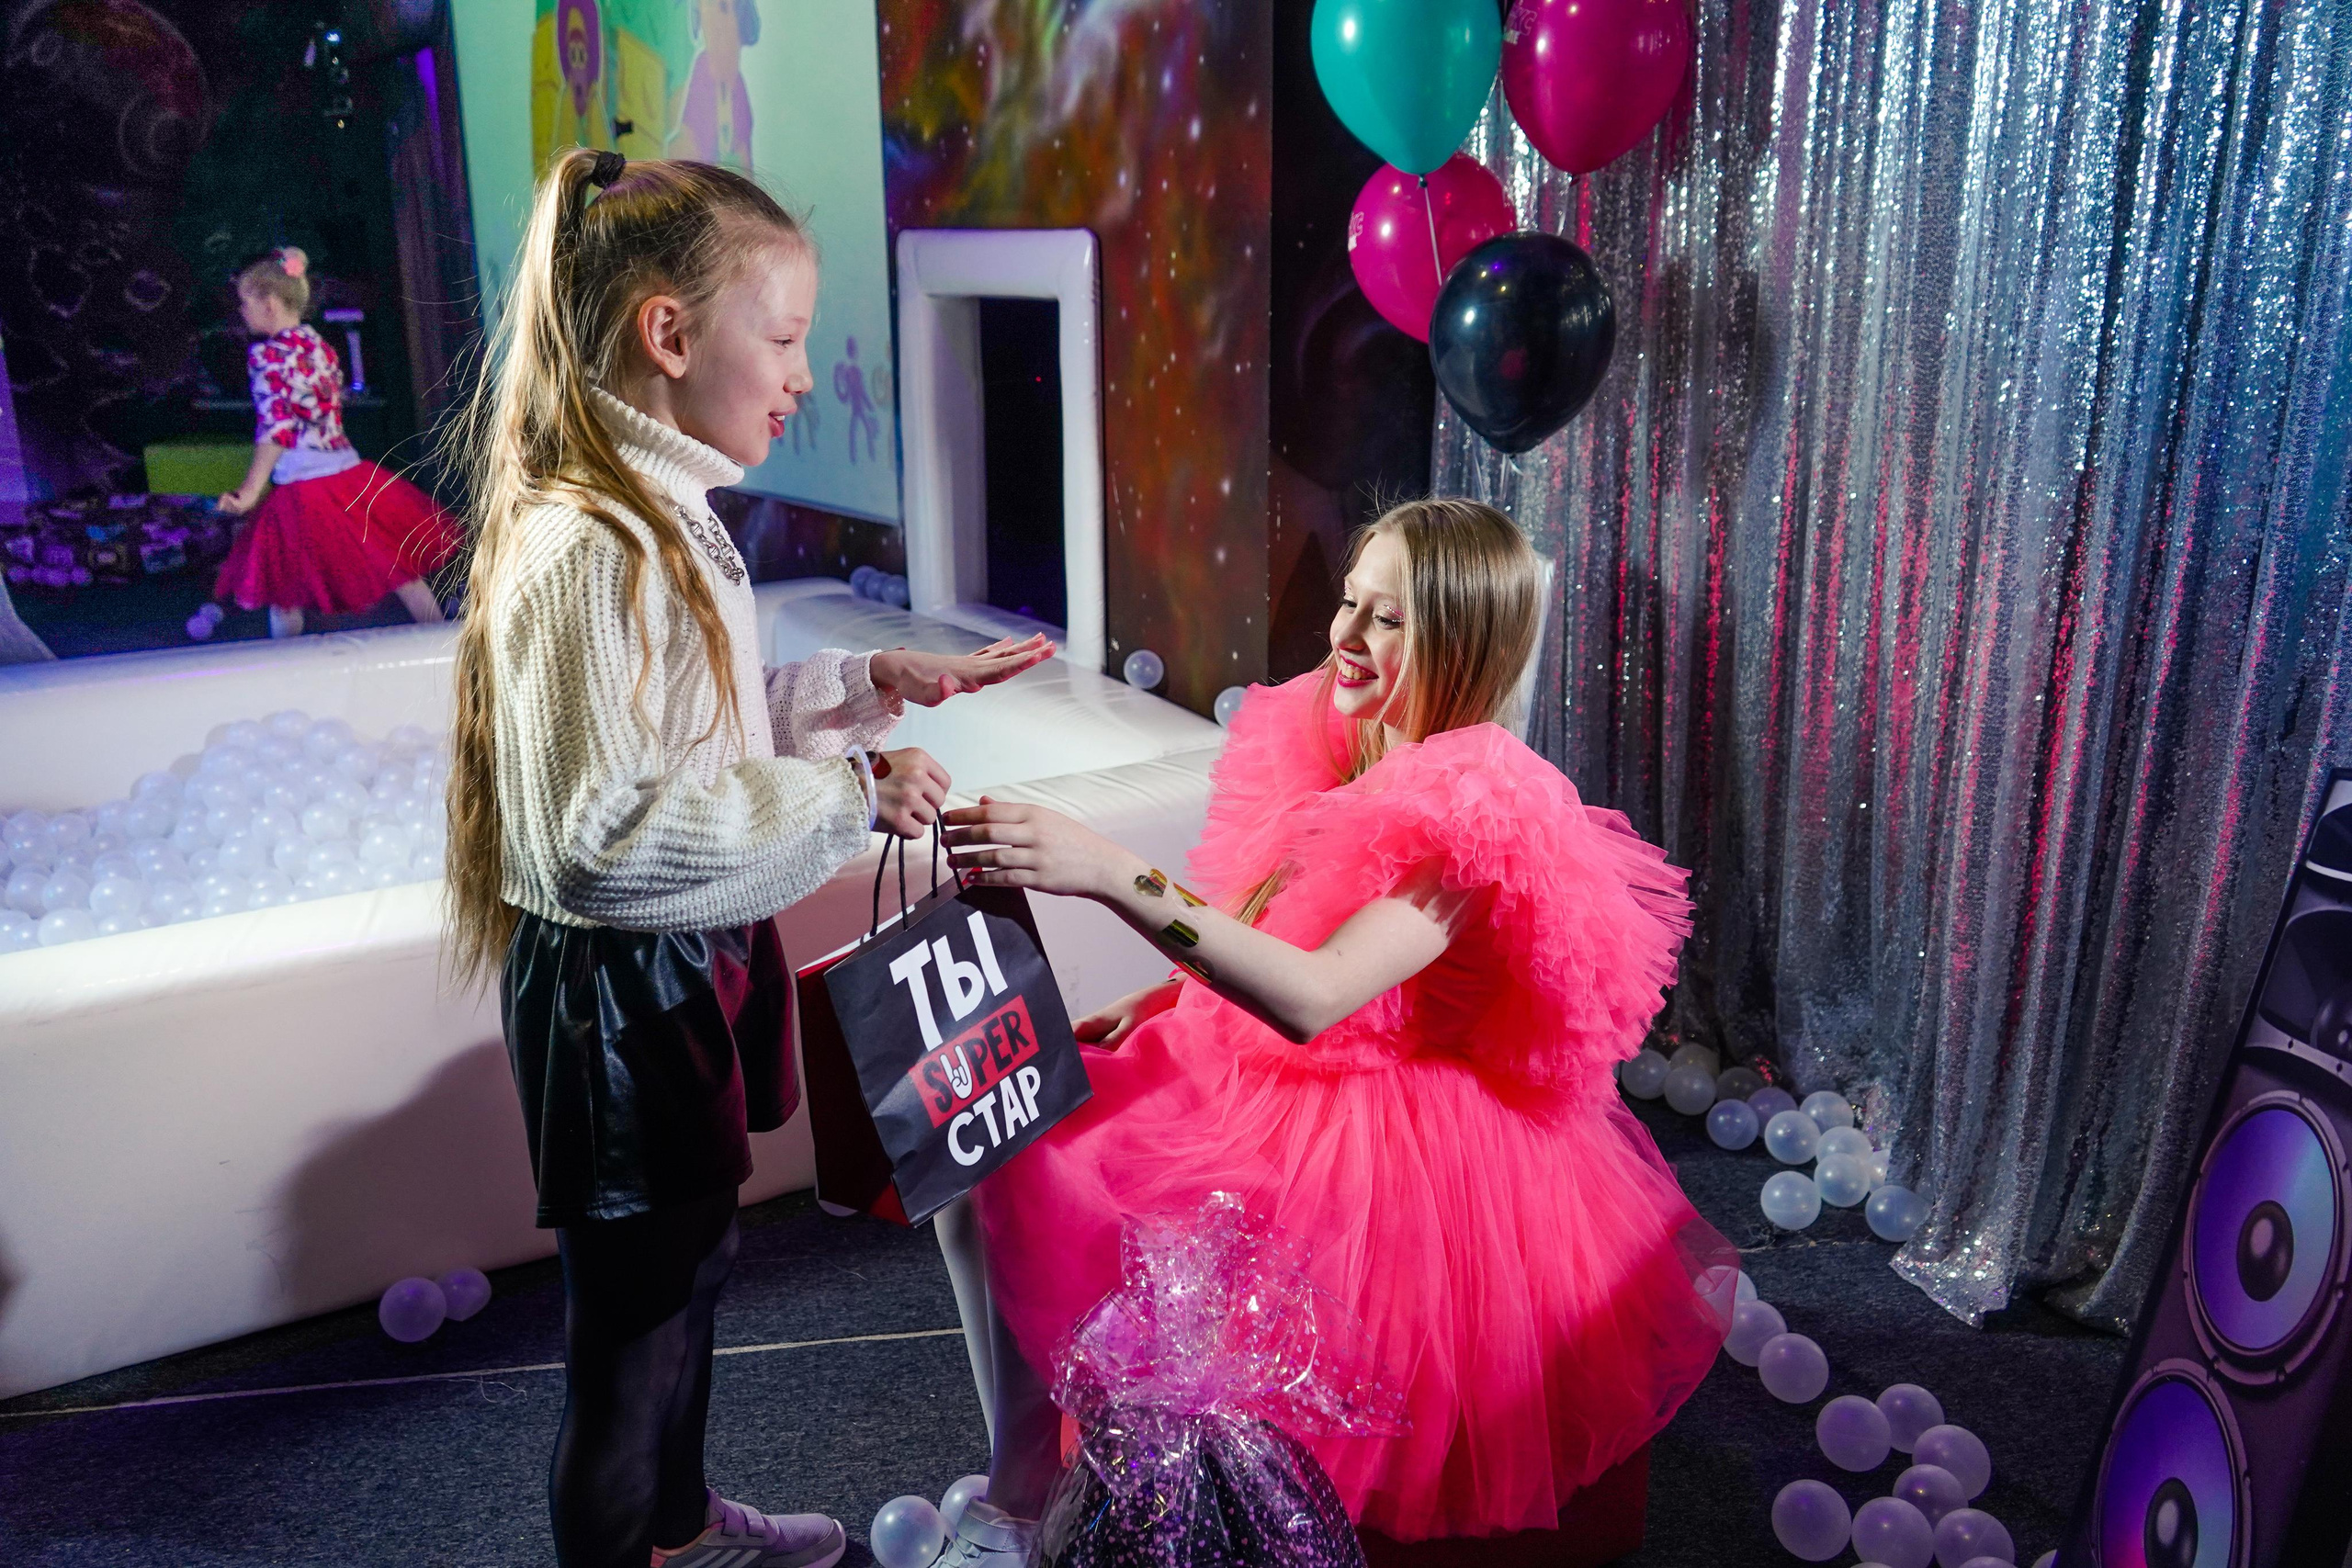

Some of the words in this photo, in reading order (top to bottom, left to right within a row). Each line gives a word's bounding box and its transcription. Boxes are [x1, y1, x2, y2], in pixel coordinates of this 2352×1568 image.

[888, 910, 1008, 1052] ТЫ
[922, 1010, 1030, 1113] SUPER
[947, 1066, 1041, 1166] СТАР
